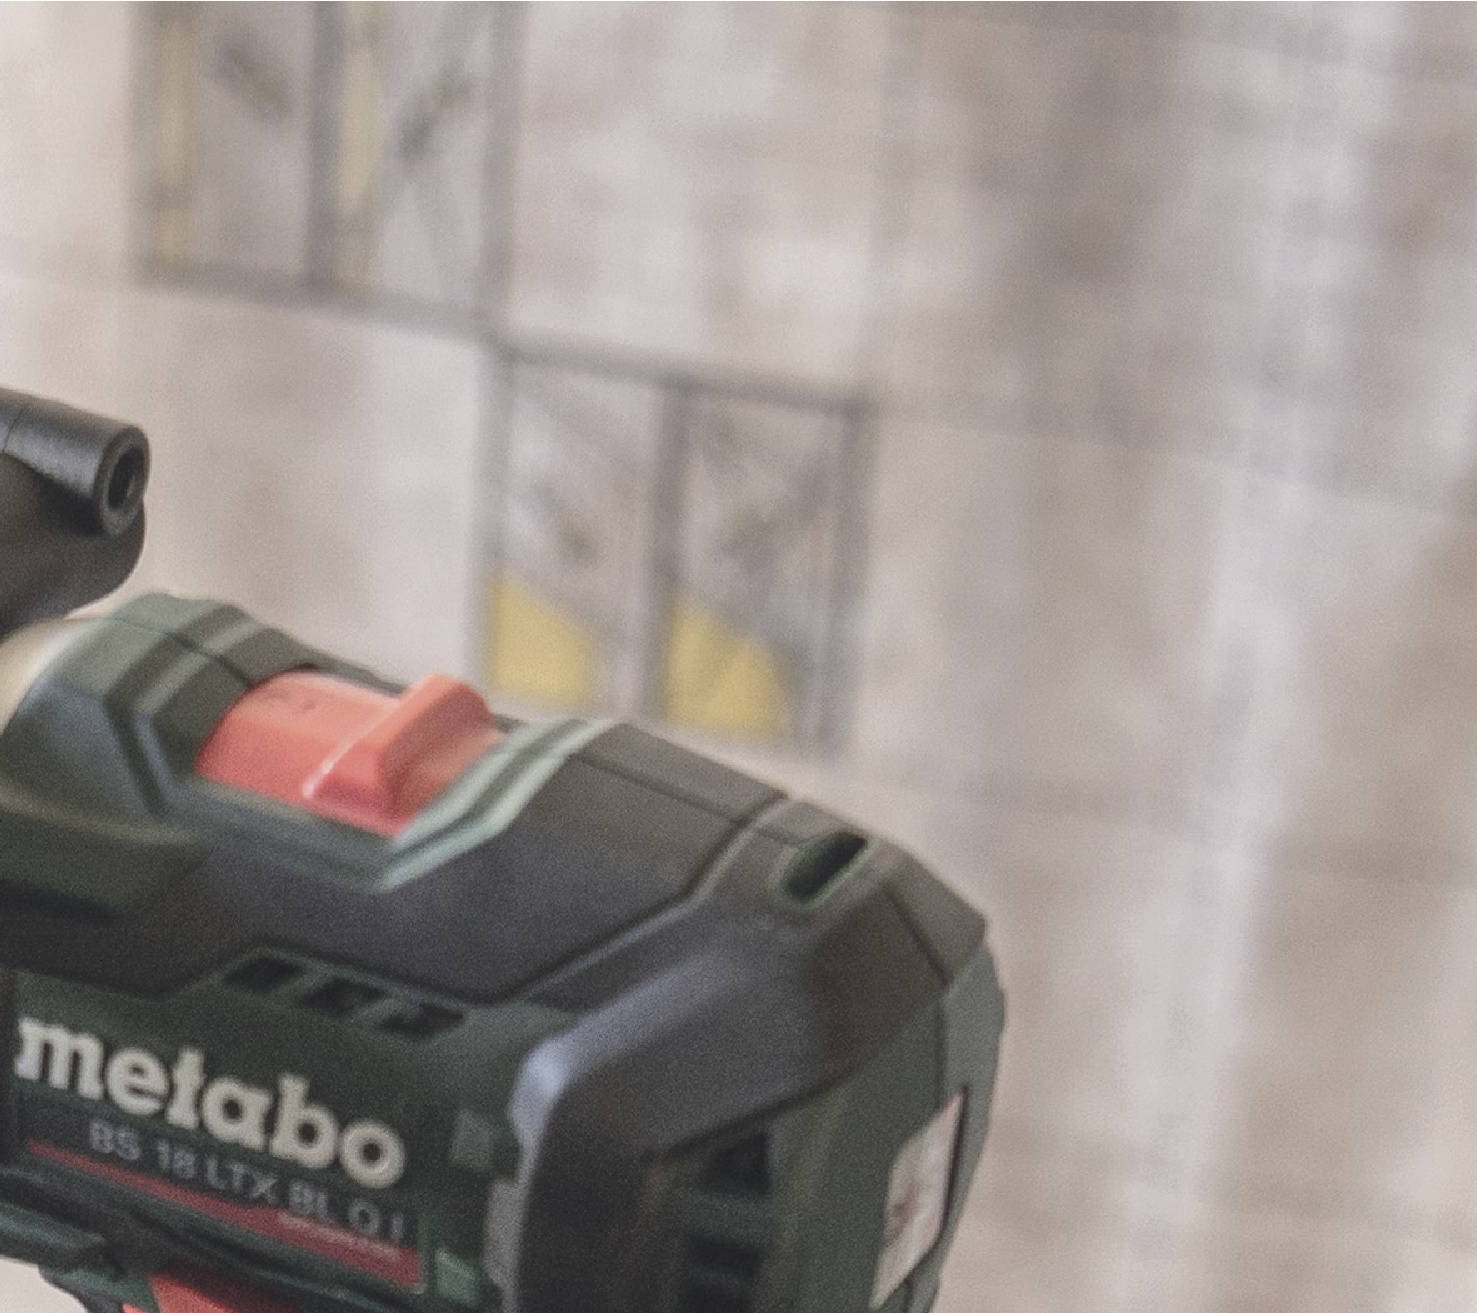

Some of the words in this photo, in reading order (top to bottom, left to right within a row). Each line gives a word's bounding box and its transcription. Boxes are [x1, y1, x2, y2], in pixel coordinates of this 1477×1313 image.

[15, 1016, 405, 1189] metabo
[89, 1118, 142, 1161] BS
[157, 1138, 197, 1180] 18
[206, 1155, 279, 1204] LTX
